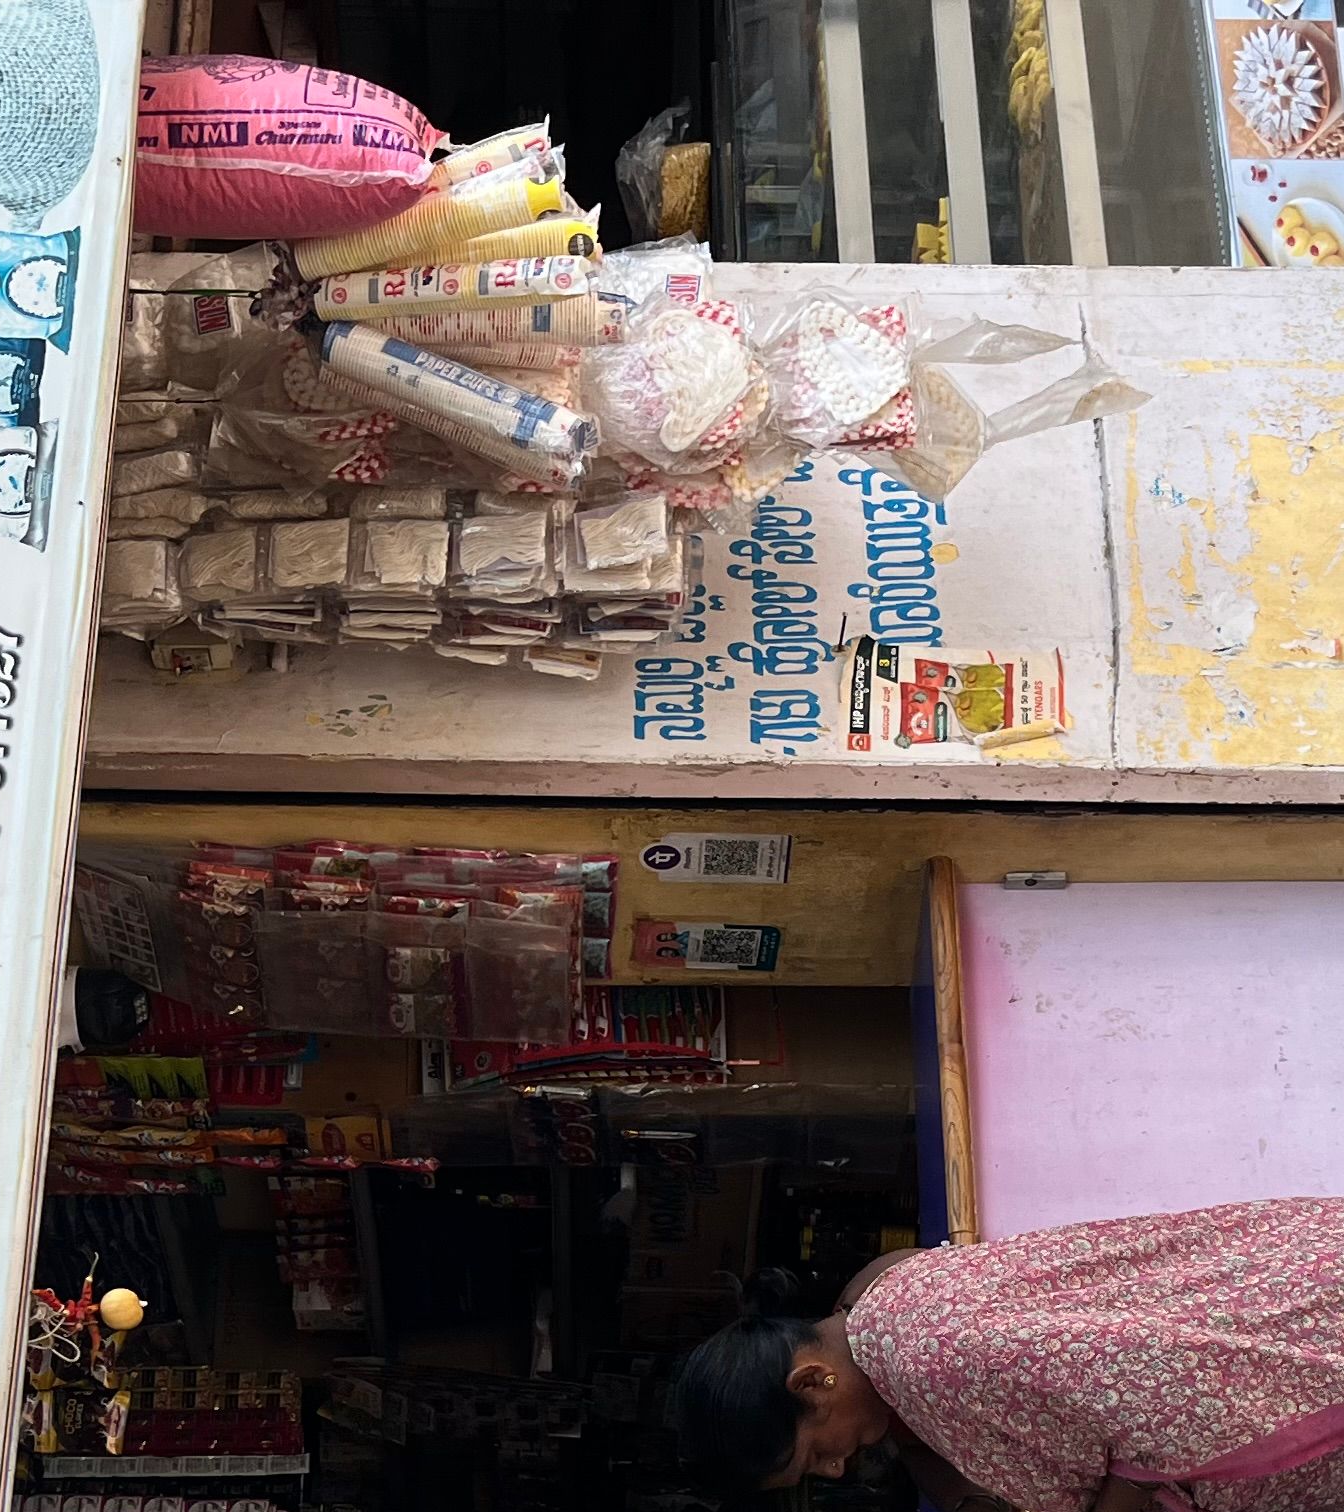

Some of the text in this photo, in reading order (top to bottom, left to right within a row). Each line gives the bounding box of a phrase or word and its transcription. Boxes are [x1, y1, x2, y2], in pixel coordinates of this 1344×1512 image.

[180, 124, 238, 145] NMI
[633, 656, 734, 740] ನಮ್ಮಲ್ಲಿ
[852, 710, 865, 728] IHP
[64, 1398, 77, 1435] CHOCO
